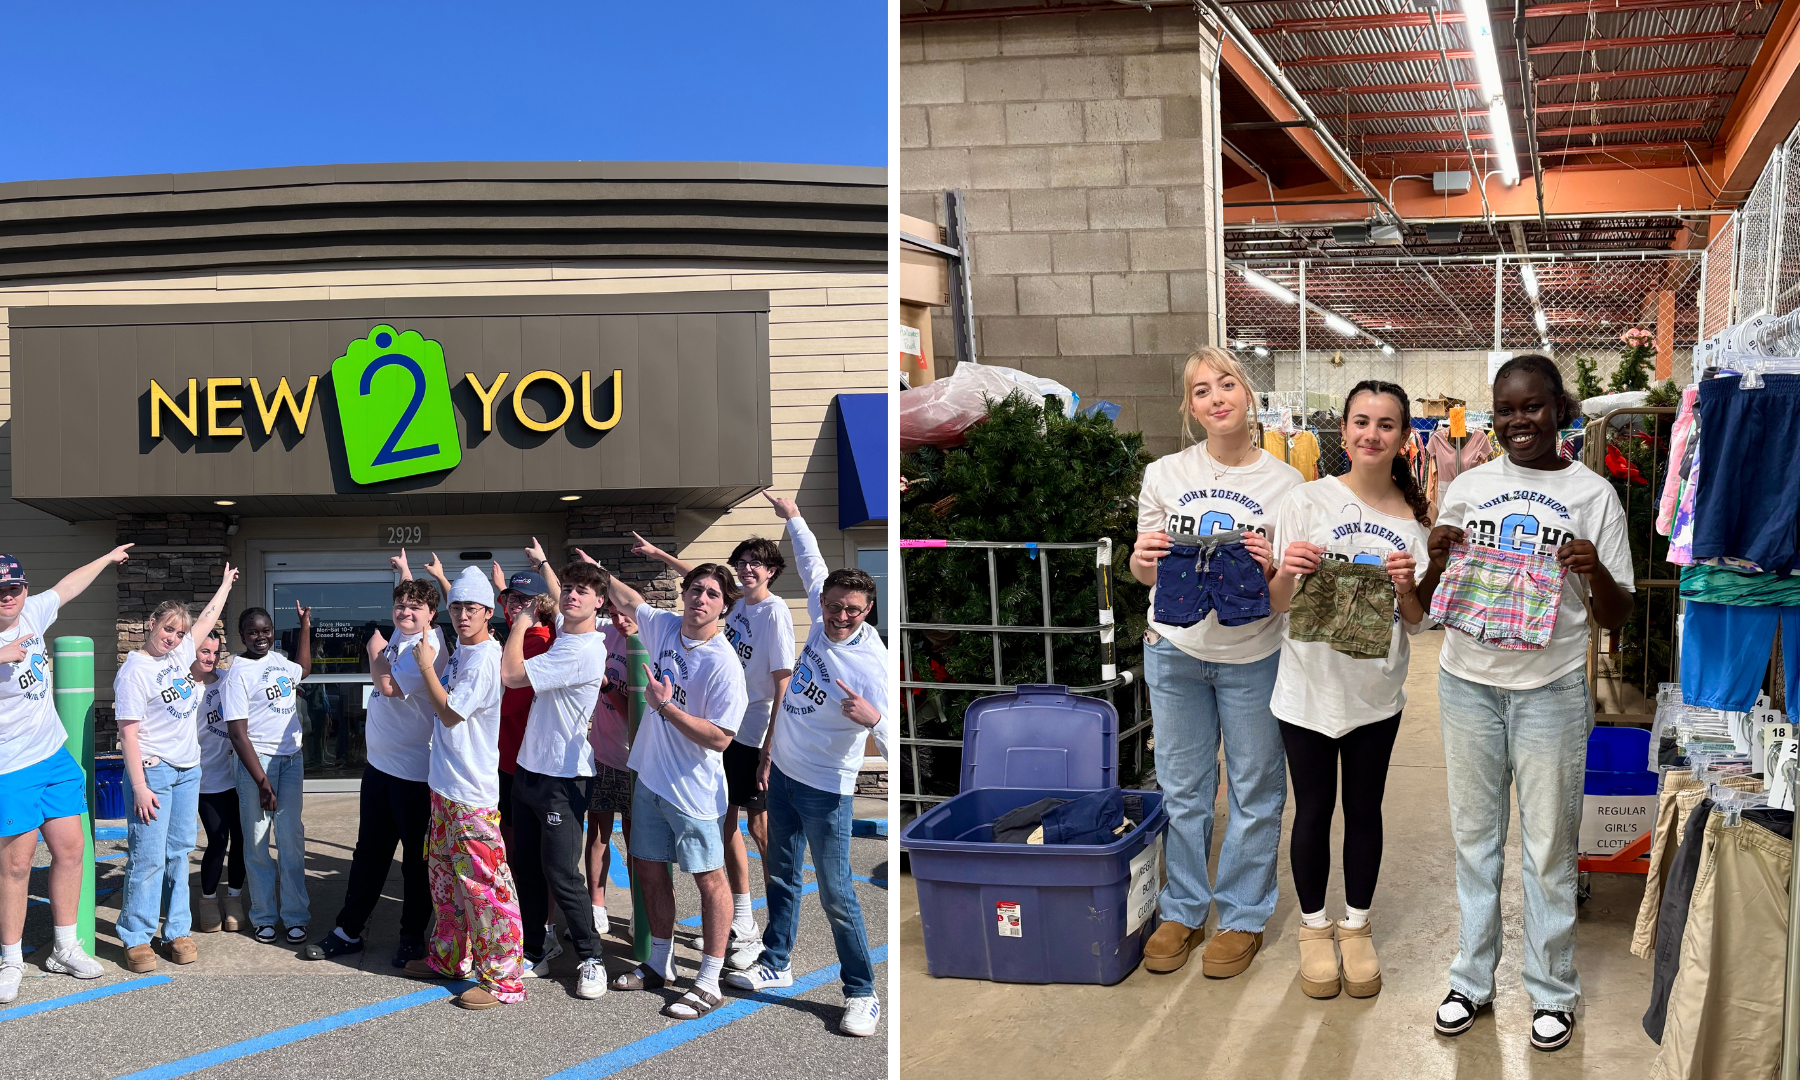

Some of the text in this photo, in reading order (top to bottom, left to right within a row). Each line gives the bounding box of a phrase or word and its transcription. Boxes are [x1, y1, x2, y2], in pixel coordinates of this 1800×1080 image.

[150, 353, 624, 467] NEW 2 YOU
[1178, 488, 1264, 516] JOHN ZOERHOFF
[1513, 490, 1571, 520] ZOERHOFF
[387, 525, 422, 544] 2929
[1332, 521, 1407, 551] JOHN ZOERHO
[672, 652, 689, 681] OERHOFF
[808, 648, 831, 684] OERHOFF
[1761, 713, 1774, 723] 16
[1772, 727, 1786, 738] 18
[1597, 806, 1646, 816] REGULAR
[1604, 823, 1638, 833] GIRL'S
[1597, 839, 1635, 849] CLOTH
[1138, 890, 1158, 919] CLOTHES
